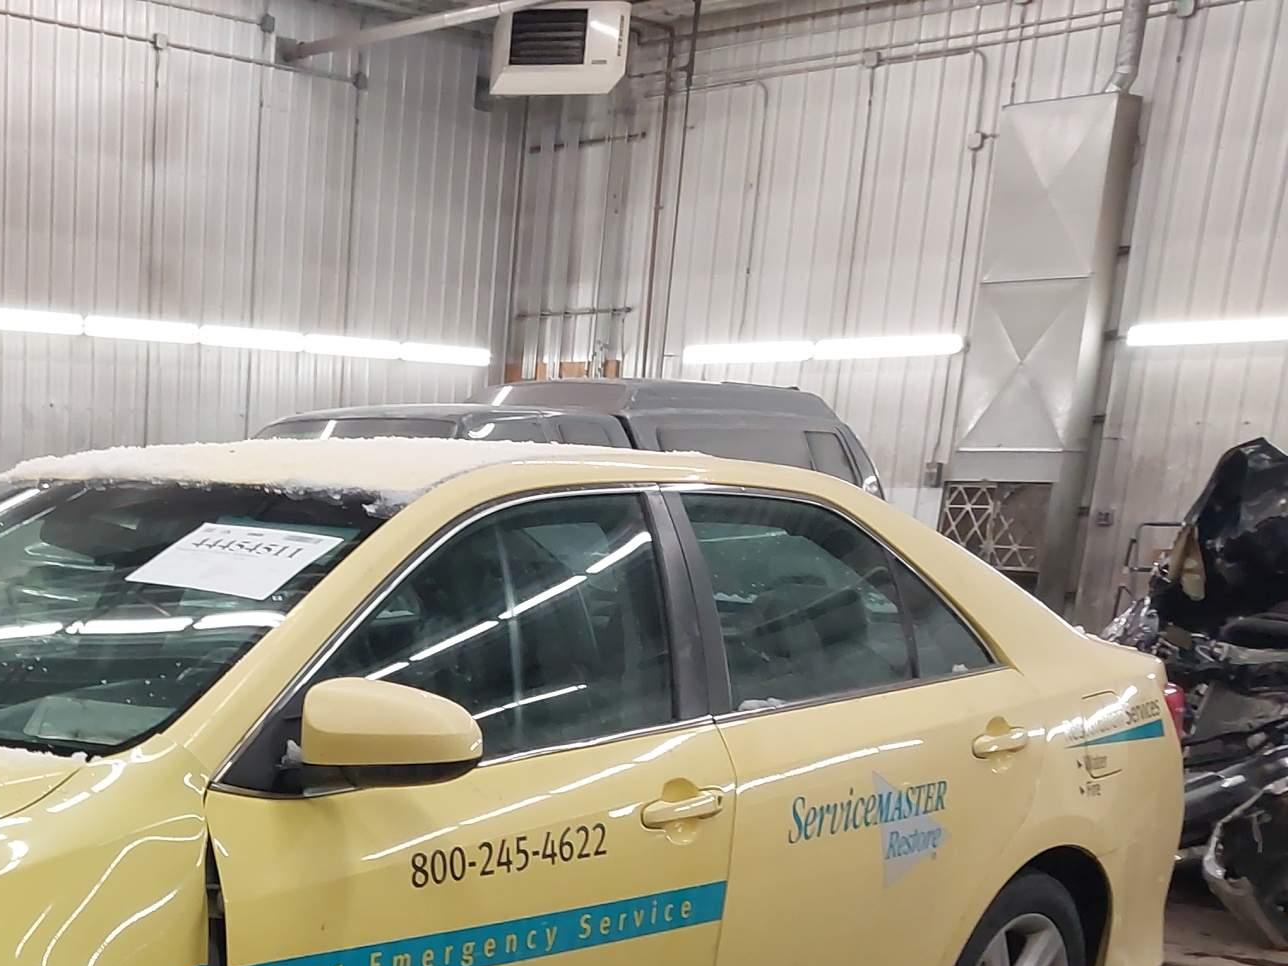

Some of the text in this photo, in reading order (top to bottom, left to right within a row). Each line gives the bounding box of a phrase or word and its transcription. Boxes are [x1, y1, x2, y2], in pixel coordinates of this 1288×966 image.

[788, 781, 947, 844] ServiceMASTER
[411, 823, 607, 888] 800-245-4622
[885, 828, 941, 860] Restore
[578, 898, 693, 940] Service
